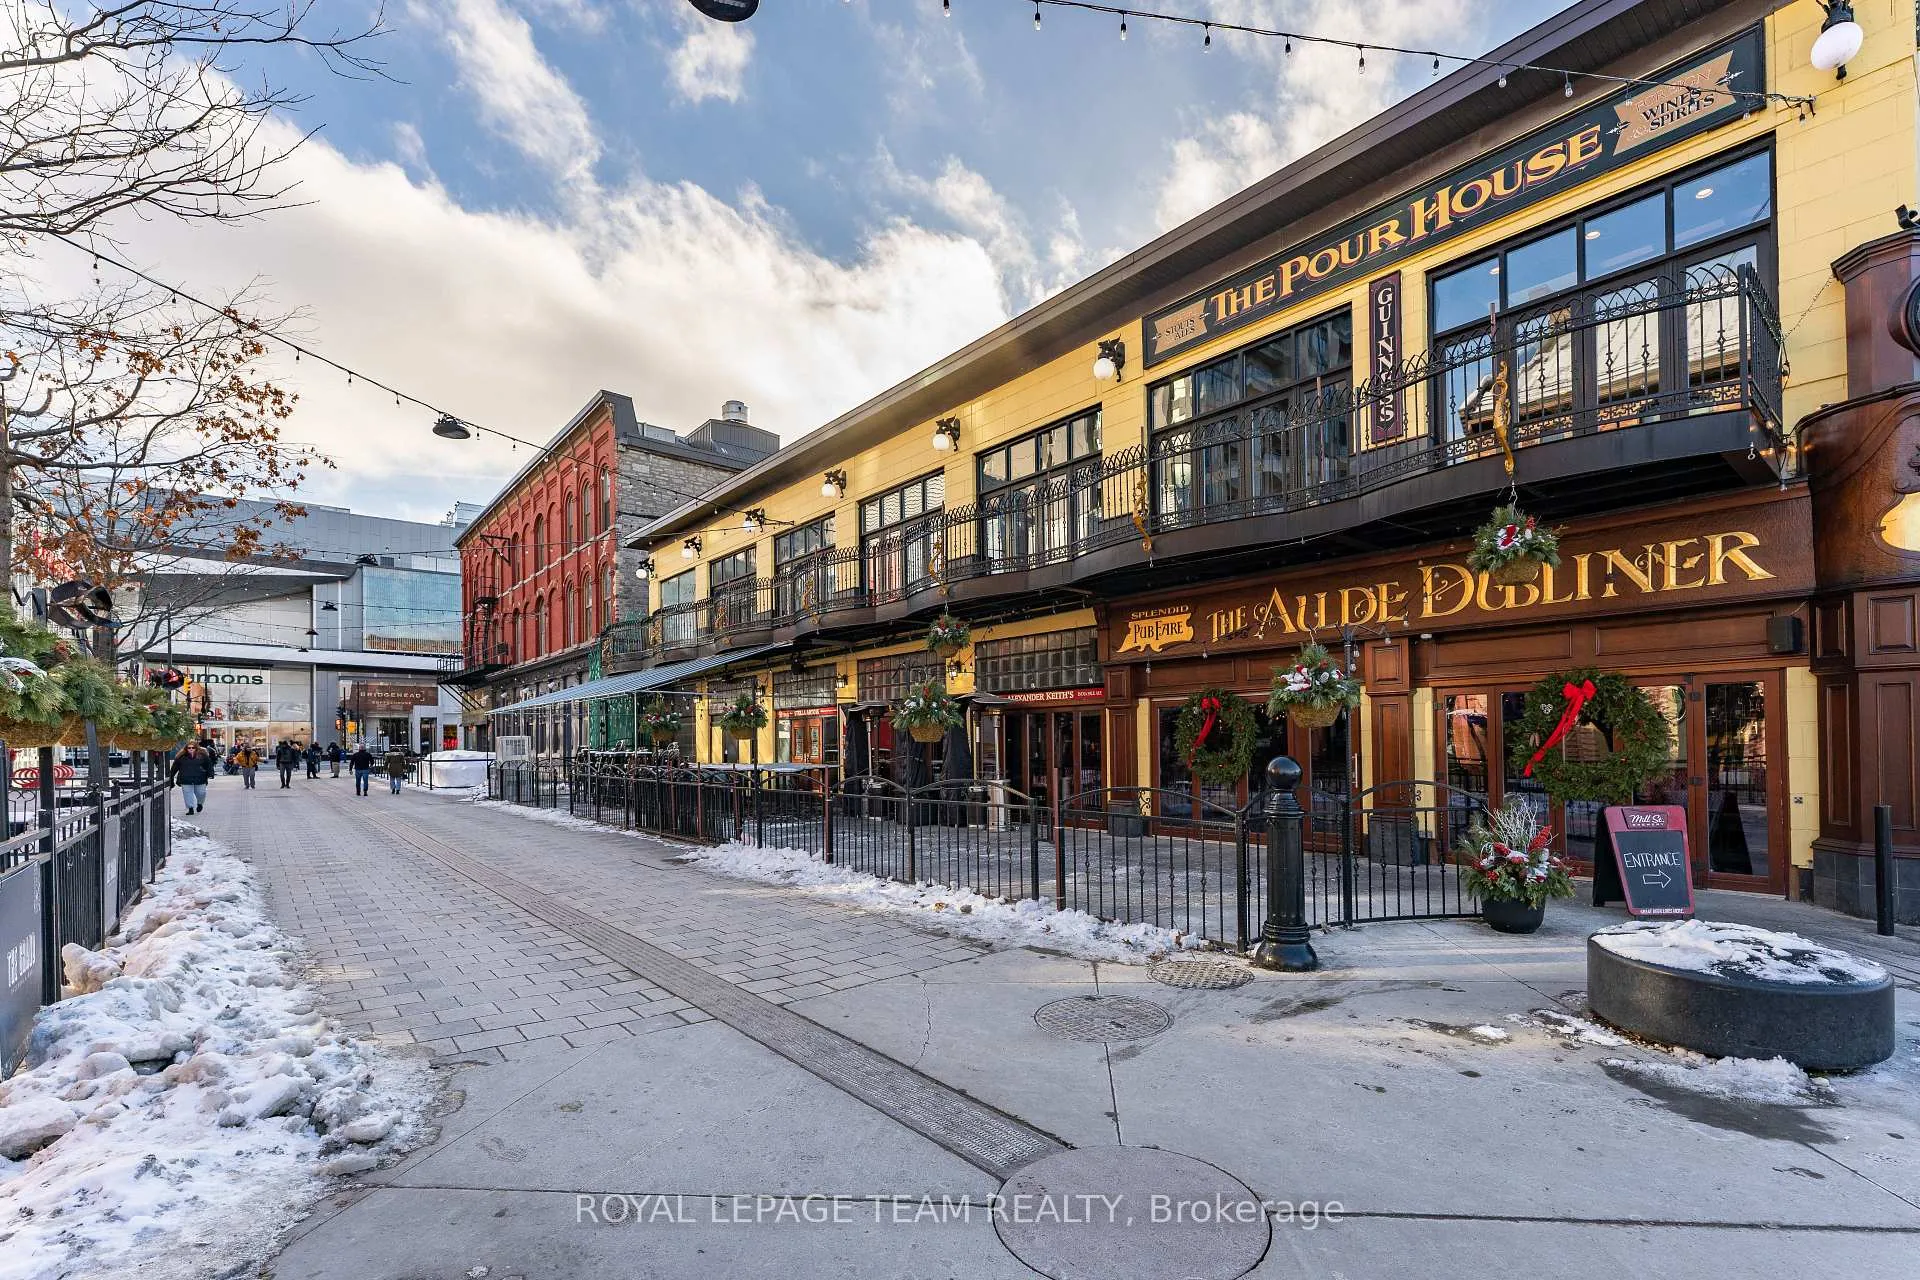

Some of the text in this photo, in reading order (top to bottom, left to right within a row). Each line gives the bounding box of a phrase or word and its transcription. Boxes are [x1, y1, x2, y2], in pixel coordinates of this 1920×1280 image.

[1641, 88, 1702, 122] WINES
[1649, 93, 1715, 131] SPIRITS
[1210, 123, 1604, 323] THE POUR HOUSE
[1206, 605, 1249, 643] THE
[1417, 530, 1778, 619] DUBLINER
[1130, 604, 1190, 621] SPLENDID
[189, 672, 264, 685] imons
[360, 691, 421, 699] BRIDGEHEAD
[1045, 690, 1074, 700] KEITH'S
[1628, 814, 1651, 823] Mill
[1623, 851, 1681, 868] ENTRANCE
